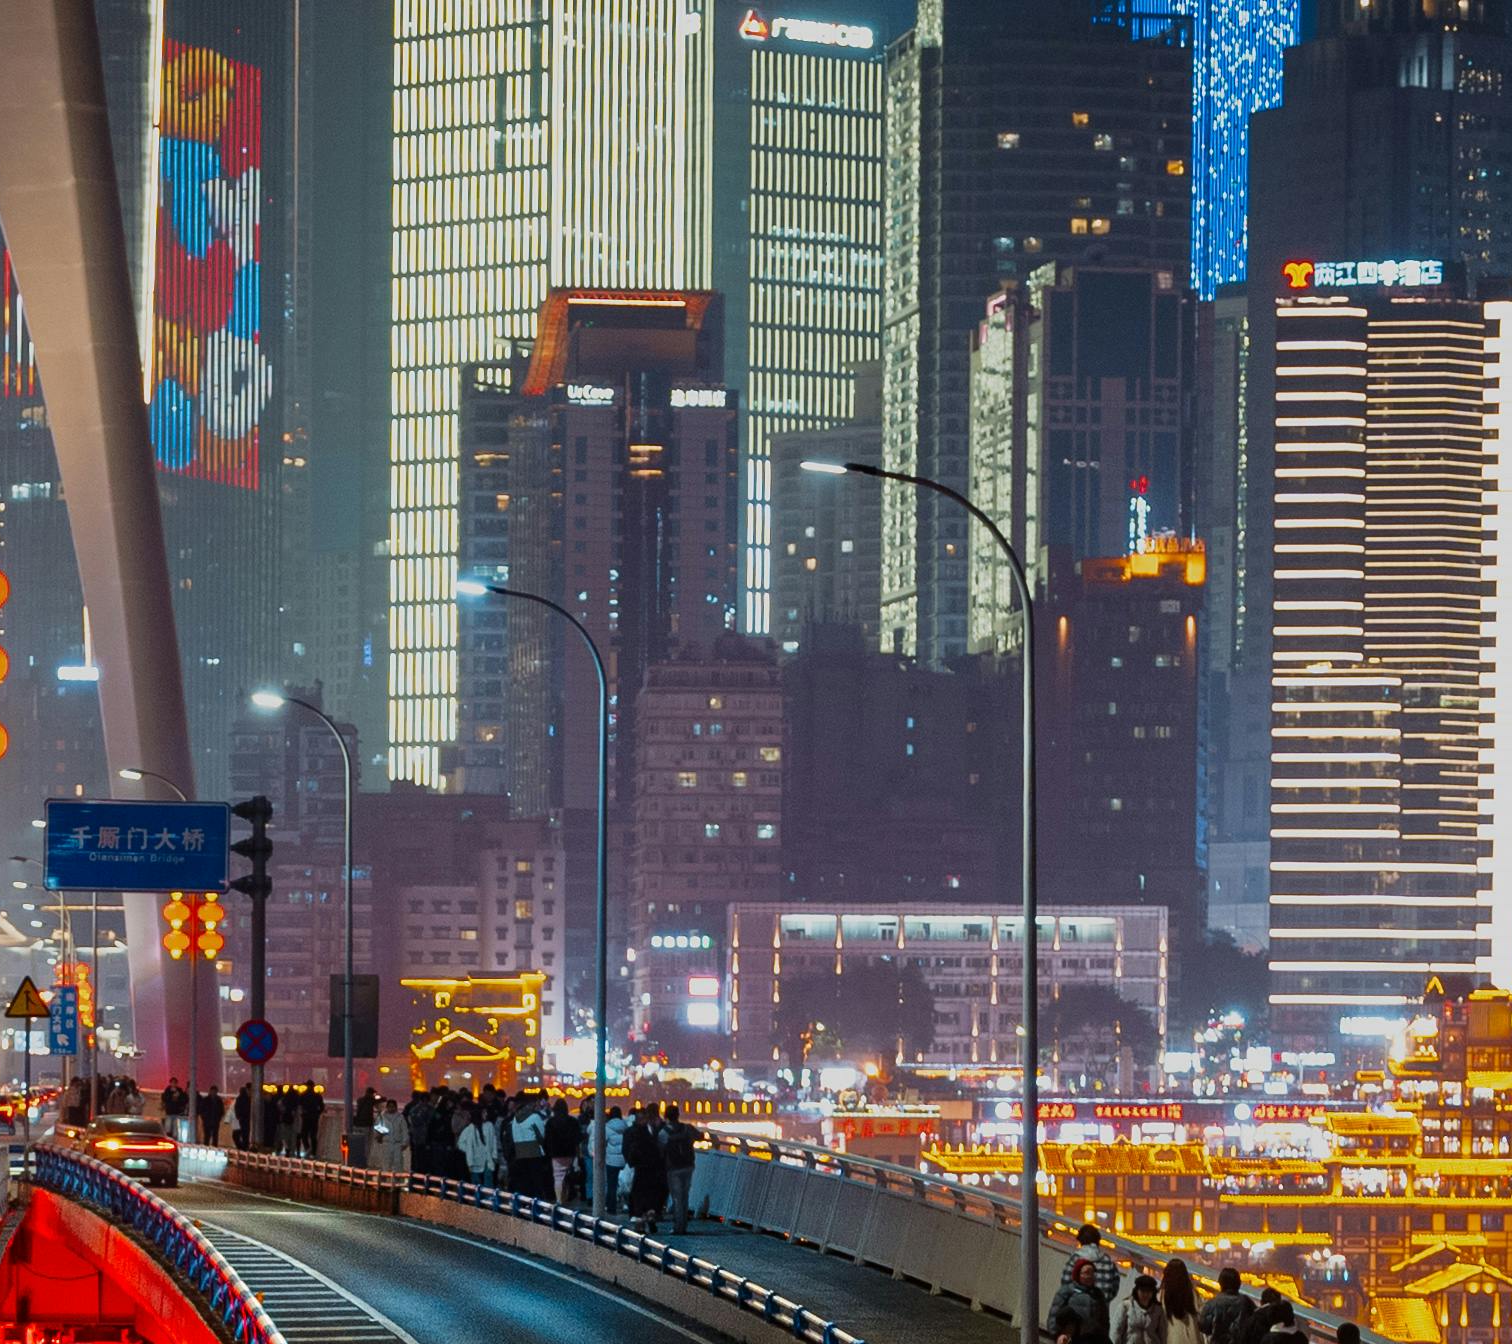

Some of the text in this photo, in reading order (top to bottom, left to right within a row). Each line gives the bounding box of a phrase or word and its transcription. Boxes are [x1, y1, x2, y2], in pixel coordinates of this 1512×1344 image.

[70, 825, 205, 851] 千厮门大桥
[150, 854, 185, 864] Bridge
